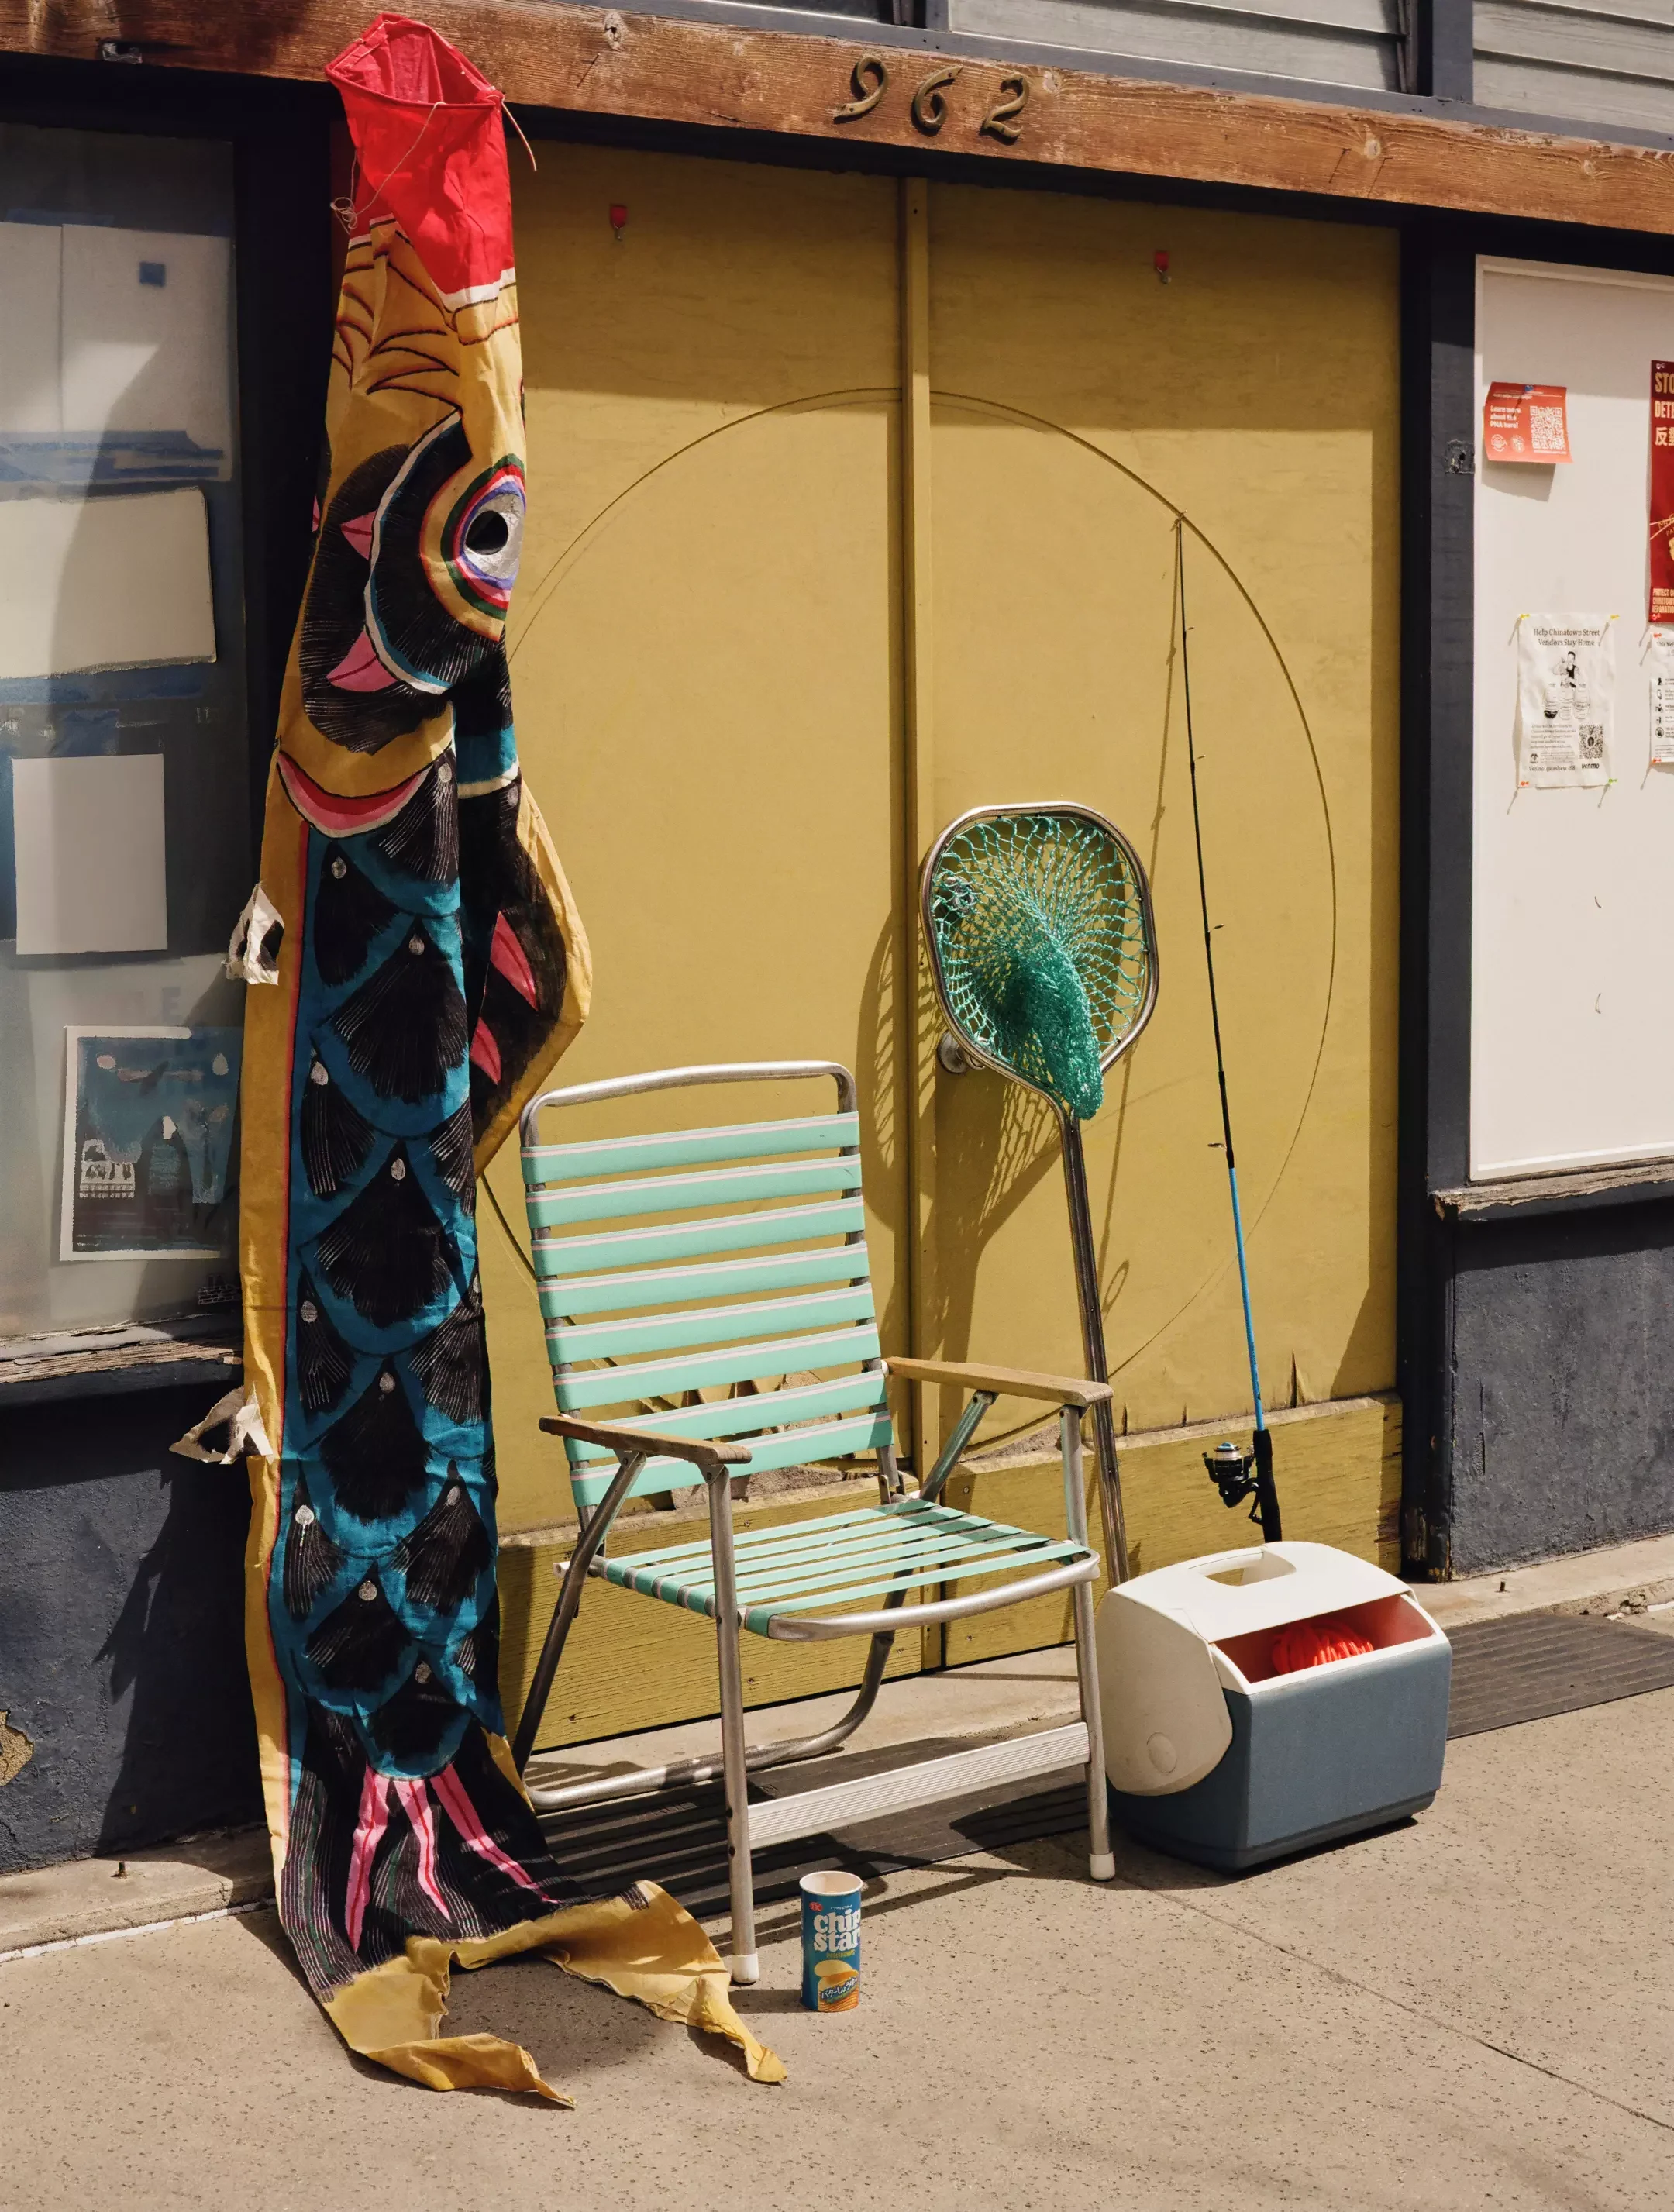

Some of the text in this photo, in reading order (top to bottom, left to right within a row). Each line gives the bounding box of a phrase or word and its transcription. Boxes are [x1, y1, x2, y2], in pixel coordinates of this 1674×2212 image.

[833, 55, 1030, 140] 962
[1534, 628, 1548, 637] Help
[1564, 639, 1576, 647] Stay
[814, 1928, 860, 1952] star
